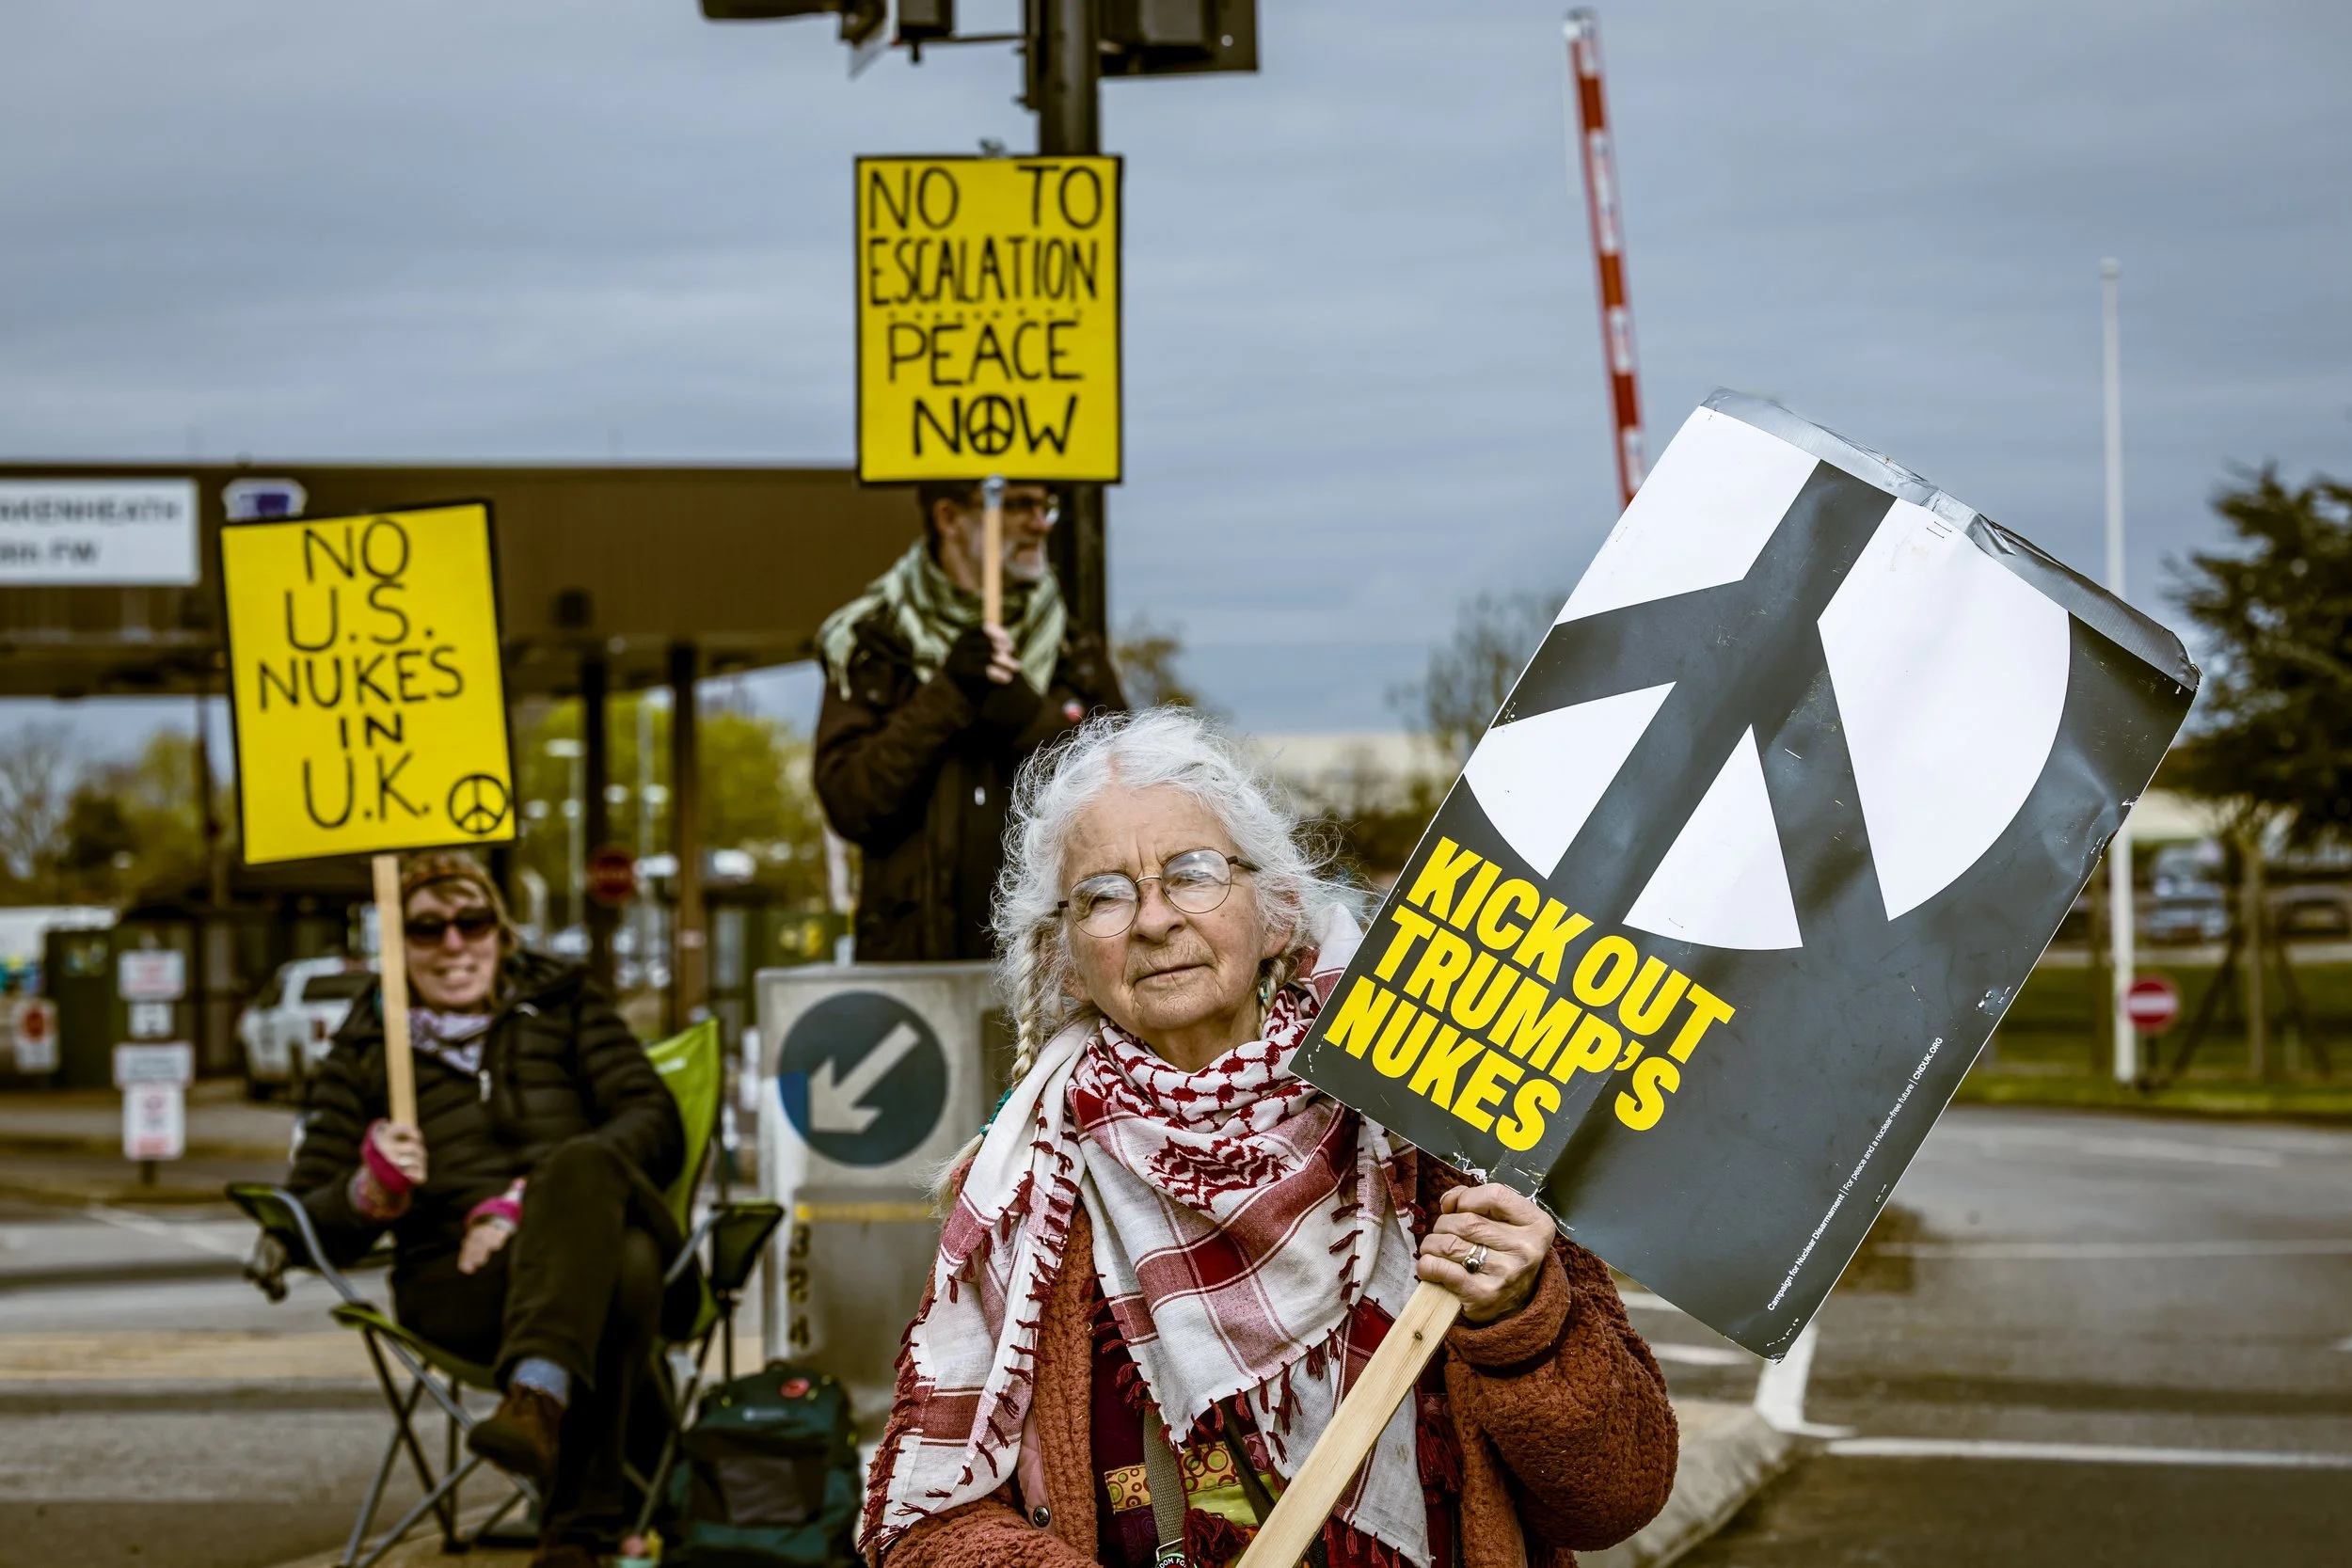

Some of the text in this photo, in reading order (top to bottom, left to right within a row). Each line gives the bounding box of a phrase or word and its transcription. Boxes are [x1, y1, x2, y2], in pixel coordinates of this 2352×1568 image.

[868, 165, 1103, 230] NO TO
[868, 234, 1098, 306] ESCALATION
[888, 320, 1084, 387] PEACE
[914, 393, 1077, 457] NOW
[302, 517, 409, 582] NO
[285, 579, 435, 652] U.S.
[259, 645, 464, 712] NUKES
[340, 711, 404, 749] IN
[303, 752, 431, 829] U.K.
[1406, 836, 1736, 1064] KICK OUT
[1374, 905, 1680, 1131] TRUMP’S
[1325, 974, 1561, 1151] NUKES
[1768, 1275, 1793, 1310] Campaign
[1788, 1265, 1799, 1276] for
[1795, 1238, 1816, 1266] Nuclear
[1812, 1194, 1845, 1240] Disarmament
[1843, 1179, 1853, 1191] For
[1851, 1159, 1867, 1180] peace
[1864, 1145, 1875, 1159] and
[1875, 1103, 1901, 1141] nuclear-free
[1898, 1085, 1914, 1103] future
[1913, 1037, 1943, 1080] CNDUK.ORG
[1158, 1557, 1174, 1568] DOM
